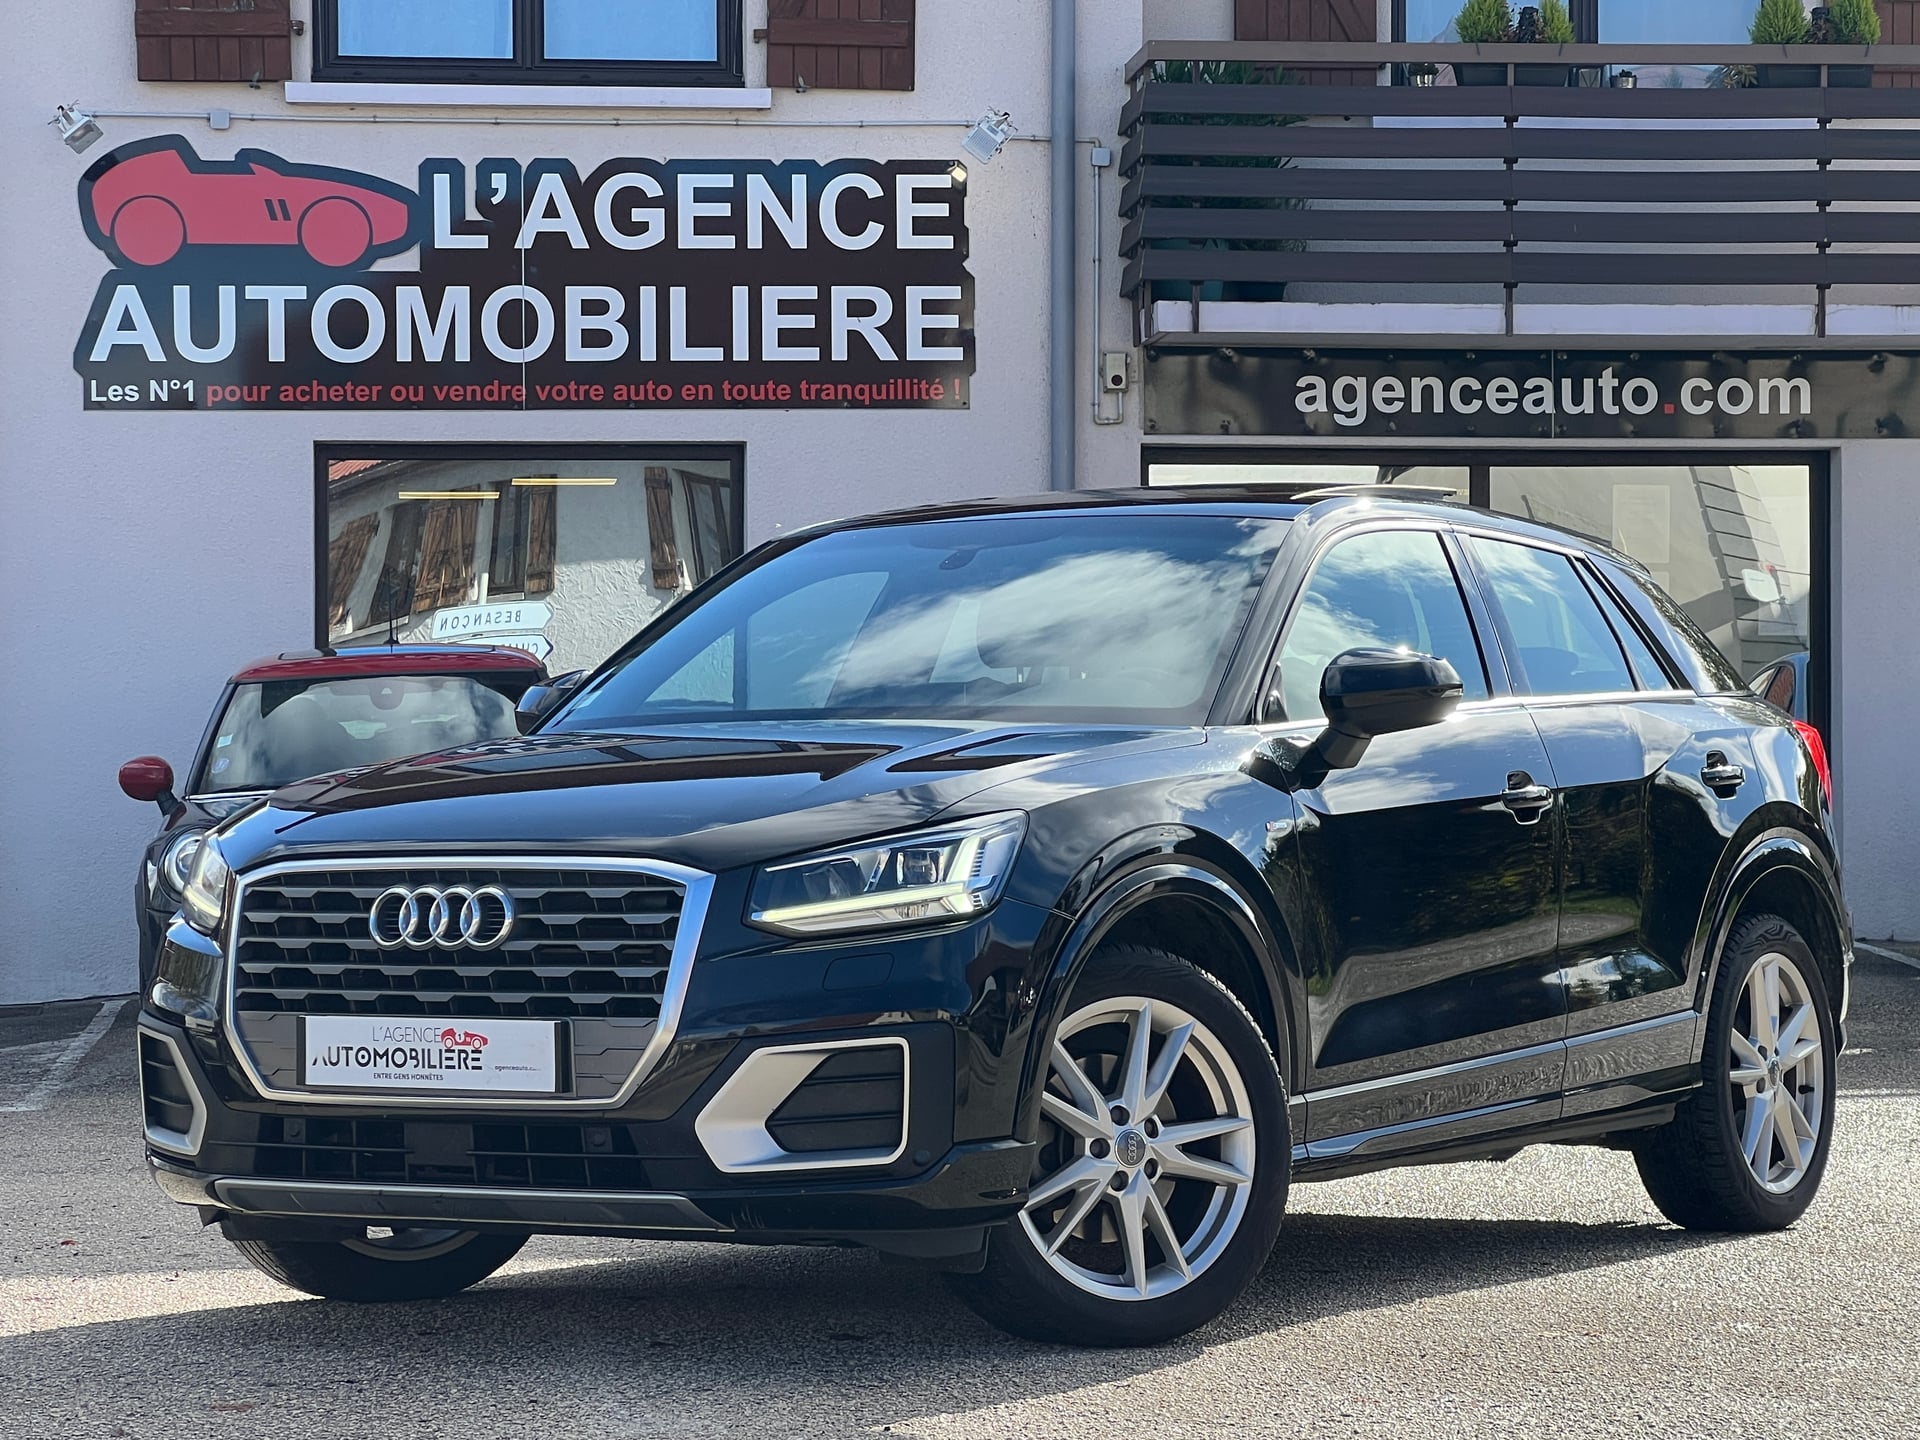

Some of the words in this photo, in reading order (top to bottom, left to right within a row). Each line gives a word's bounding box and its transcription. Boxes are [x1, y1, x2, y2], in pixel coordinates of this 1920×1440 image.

[433, 173, 954, 250] L'AGENCE
[89, 284, 964, 364] AUTOMOBILIERE
[90, 380, 140, 402] Les
[149, 379, 195, 402] N°1
[206, 383, 270, 406] pour
[279, 380, 383, 402] acheter
[390, 384, 424, 402] ou
[433, 380, 527, 402] vendre
[536, 382, 604, 402] votre
[613, 382, 673, 402] auto
[681, 386, 714, 402] en
[722, 382, 792, 402] toute
[800, 378, 945, 405] tranquillité
[1294, 366, 1812, 426] agenceauto.com
[372, 1026, 442, 1044] L'AGENCE
